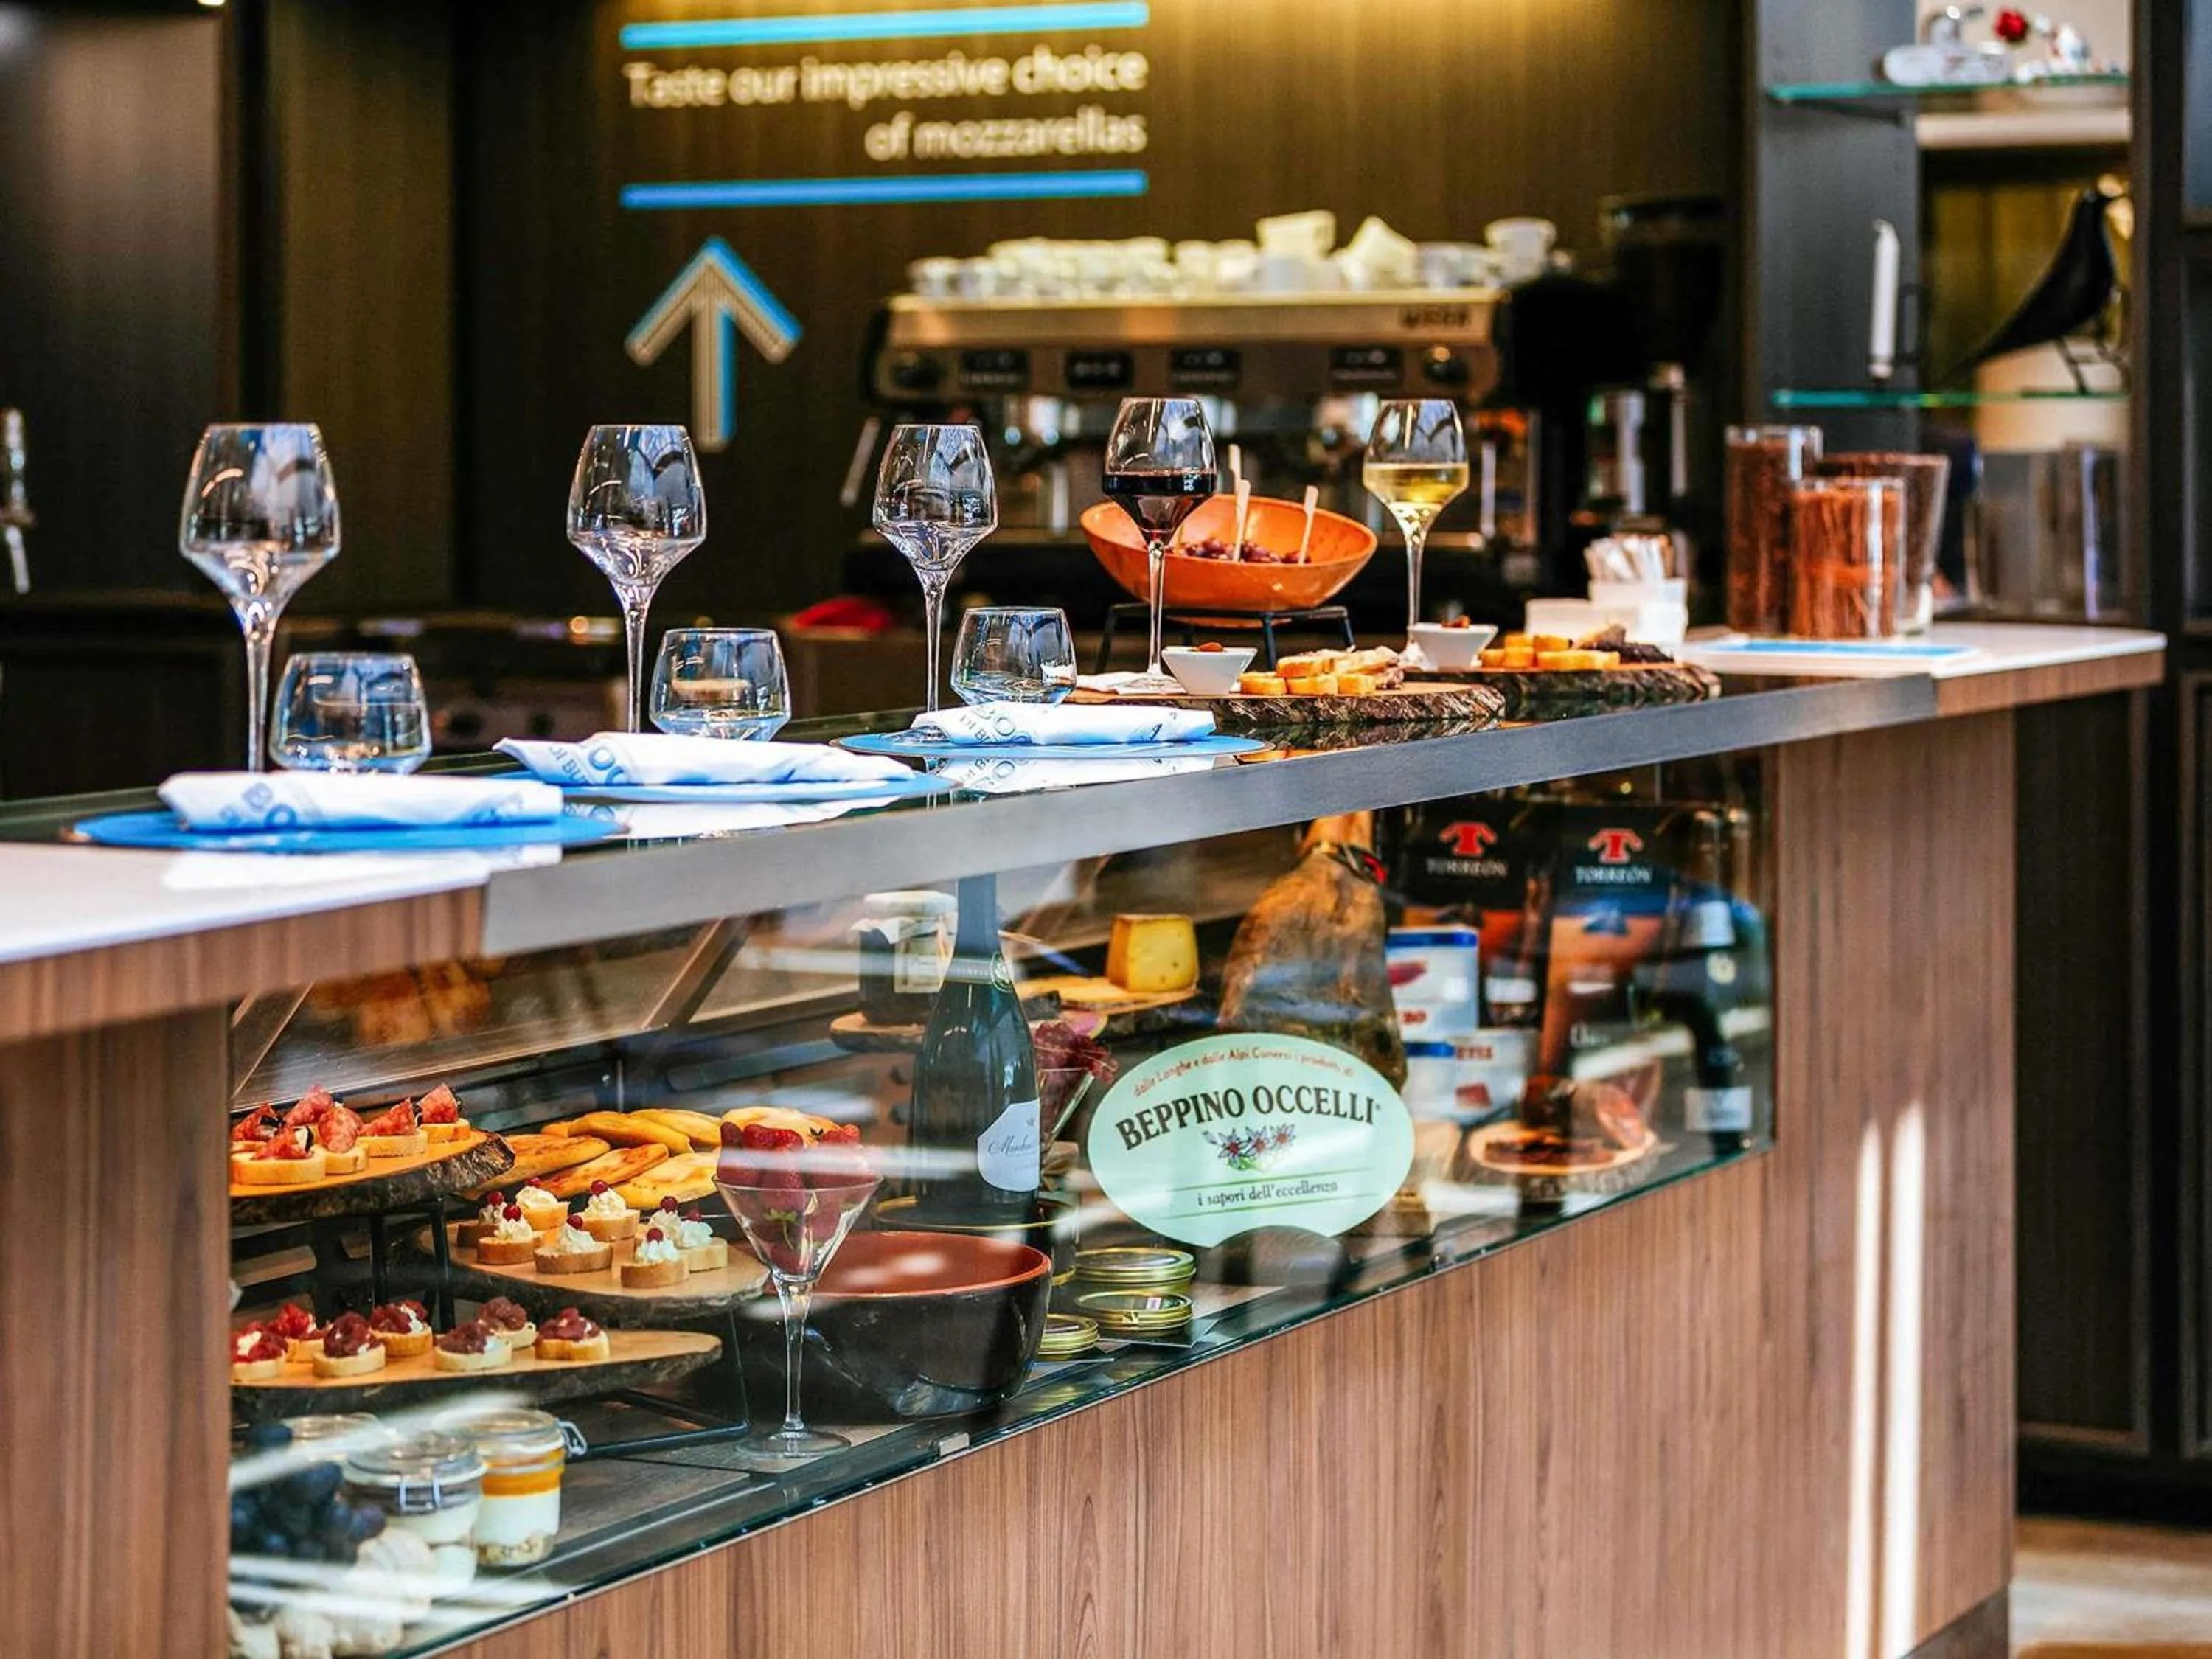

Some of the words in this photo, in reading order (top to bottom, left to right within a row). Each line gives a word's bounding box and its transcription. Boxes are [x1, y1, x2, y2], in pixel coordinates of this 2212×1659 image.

[623, 61, 728, 108] Taste
[728, 65, 796, 105] our
[800, 49, 1010, 110] impressive
[1012, 44, 1148, 94] choice
[865, 111, 915, 161] of
[914, 106, 1148, 159] mozzarellas
[1228, 1048, 1249, 1061] Alpi
[1115, 1088, 1245, 1151] BEPPINO
[1253, 1084, 1374, 1125] OCCELLI
[1197, 1192, 1203, 1207] i
[1207, 1188, 1245, 1208] sapori
[1248, 1179, 1339, 1200] dell'eccellenza
